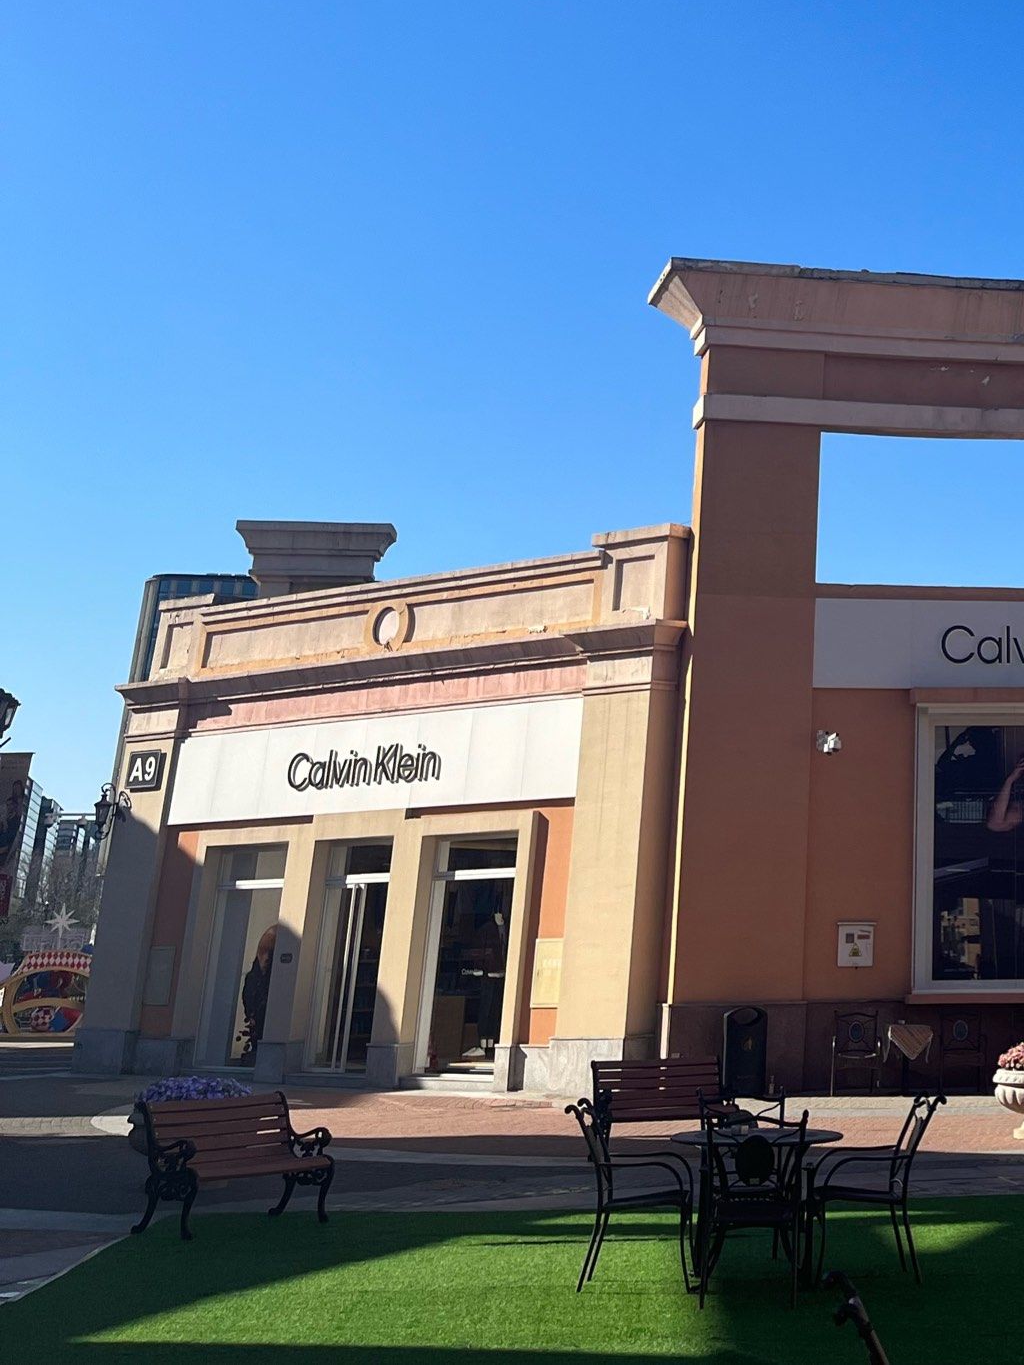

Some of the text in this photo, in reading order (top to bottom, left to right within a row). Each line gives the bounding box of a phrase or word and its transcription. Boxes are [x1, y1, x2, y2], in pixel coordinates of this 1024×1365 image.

[129, 756, 156, 782] A9
[287, 743, 441, 791] Calvin Klein
